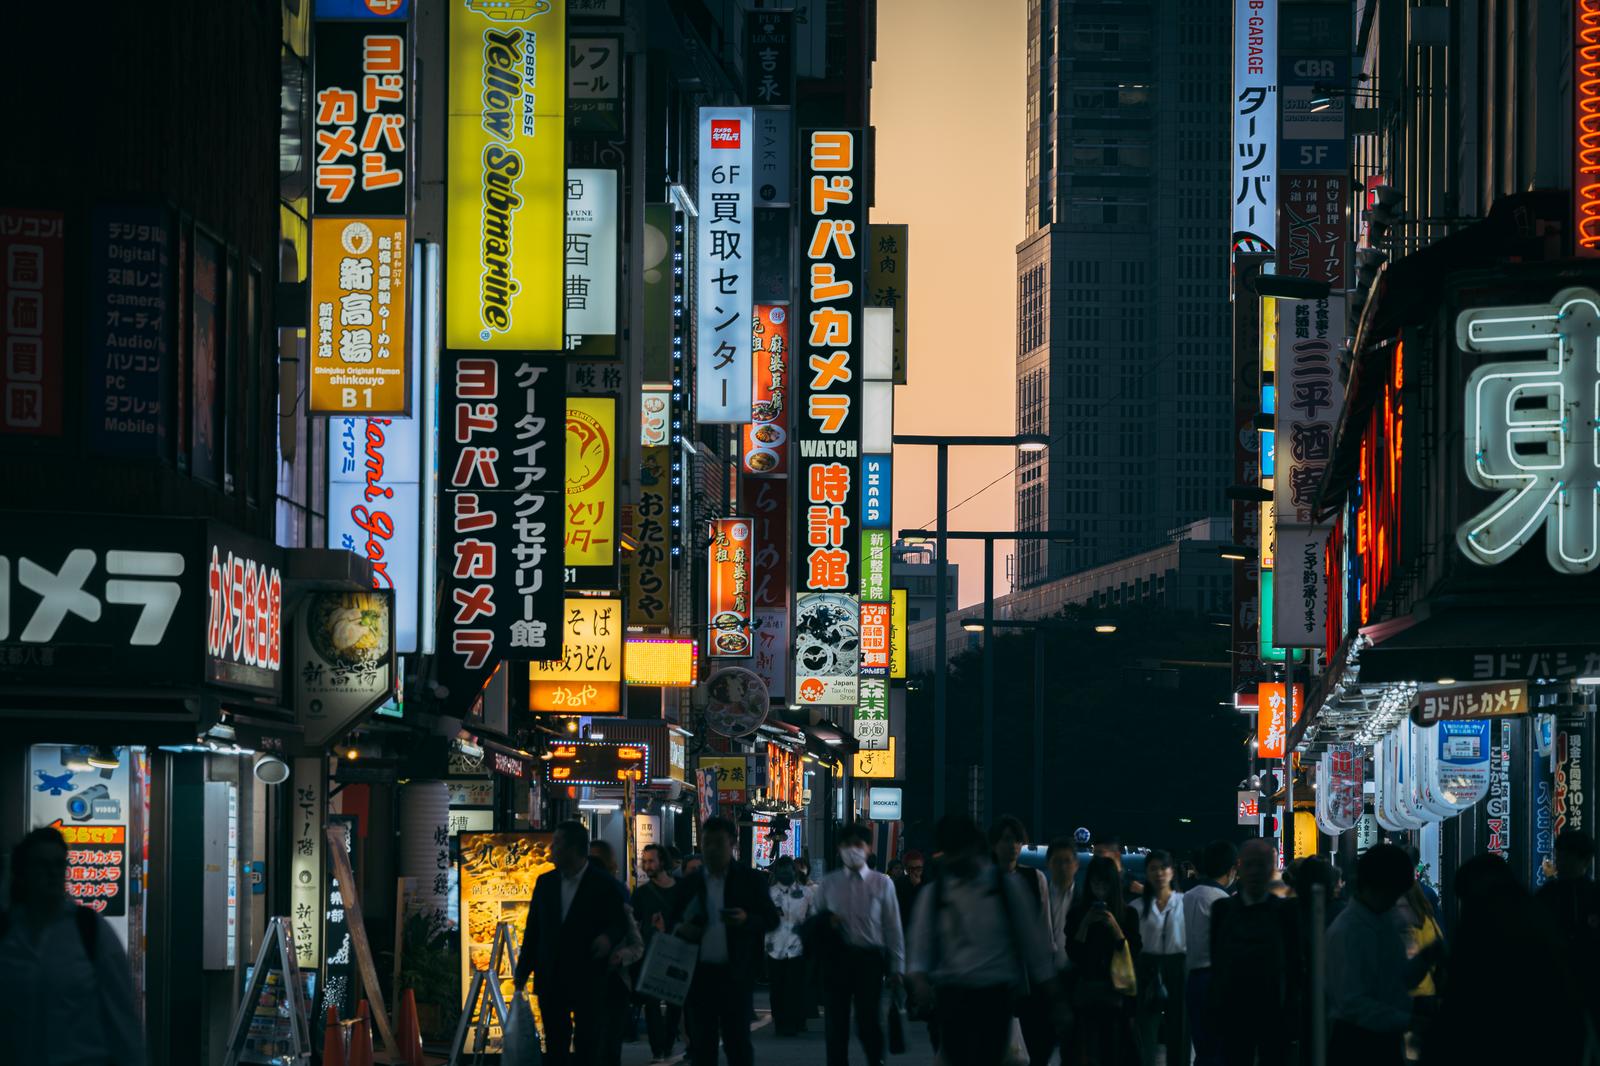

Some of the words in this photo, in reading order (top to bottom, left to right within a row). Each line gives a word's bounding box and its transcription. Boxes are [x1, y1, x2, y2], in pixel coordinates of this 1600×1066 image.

[483, 27, 524, 142] Yellow
[524, 31, 537, 88] HOBBY
[1294, 59, 1335, 77] CBR
[362, 34, 404, 191] ヨドバシ
[522, 93, 535, 137] BASE
[316, 86, 357, 202] カメラ
[1237, 85, 1276, 228] ダーツバー
[1300, 145, 1328, 165] 5F
[711, 165, 740, 184] 6F
[108, 245, 156, 263] Digital
[479, 142, 524, 332] Submarine
[1324, 231, 1340, 283] シーアン
[709, 192, 742, 407] 買取センター
[807, 130, 856, 434] ヨドバシカメラ
[106, 375, 126, 390] PC
[315, 367, 345, 376] Shinjuku
[347, 367, 374, 376] Original
[376, 367, 400, 375] Ramen
[104, 418, 155, 434] Mobile
[800, 439, 848, 458] WATCH
[452, 359, 499, 669] ヨドバシカメラ
[510, 362, 548, 648] ケータイアクセサリー館
[806, 461, 854, 590] 時計館
[638, 492, 664, 620] おたからや
[0, 547, 186, 646] メラ
[208, 544, 282, 672] カメラ総合館
[567, 607, 612, 637] そば
[860, 605, 887, 615] スマホ
[1423, 688, 1522, 720] ヨドバシカメラ
